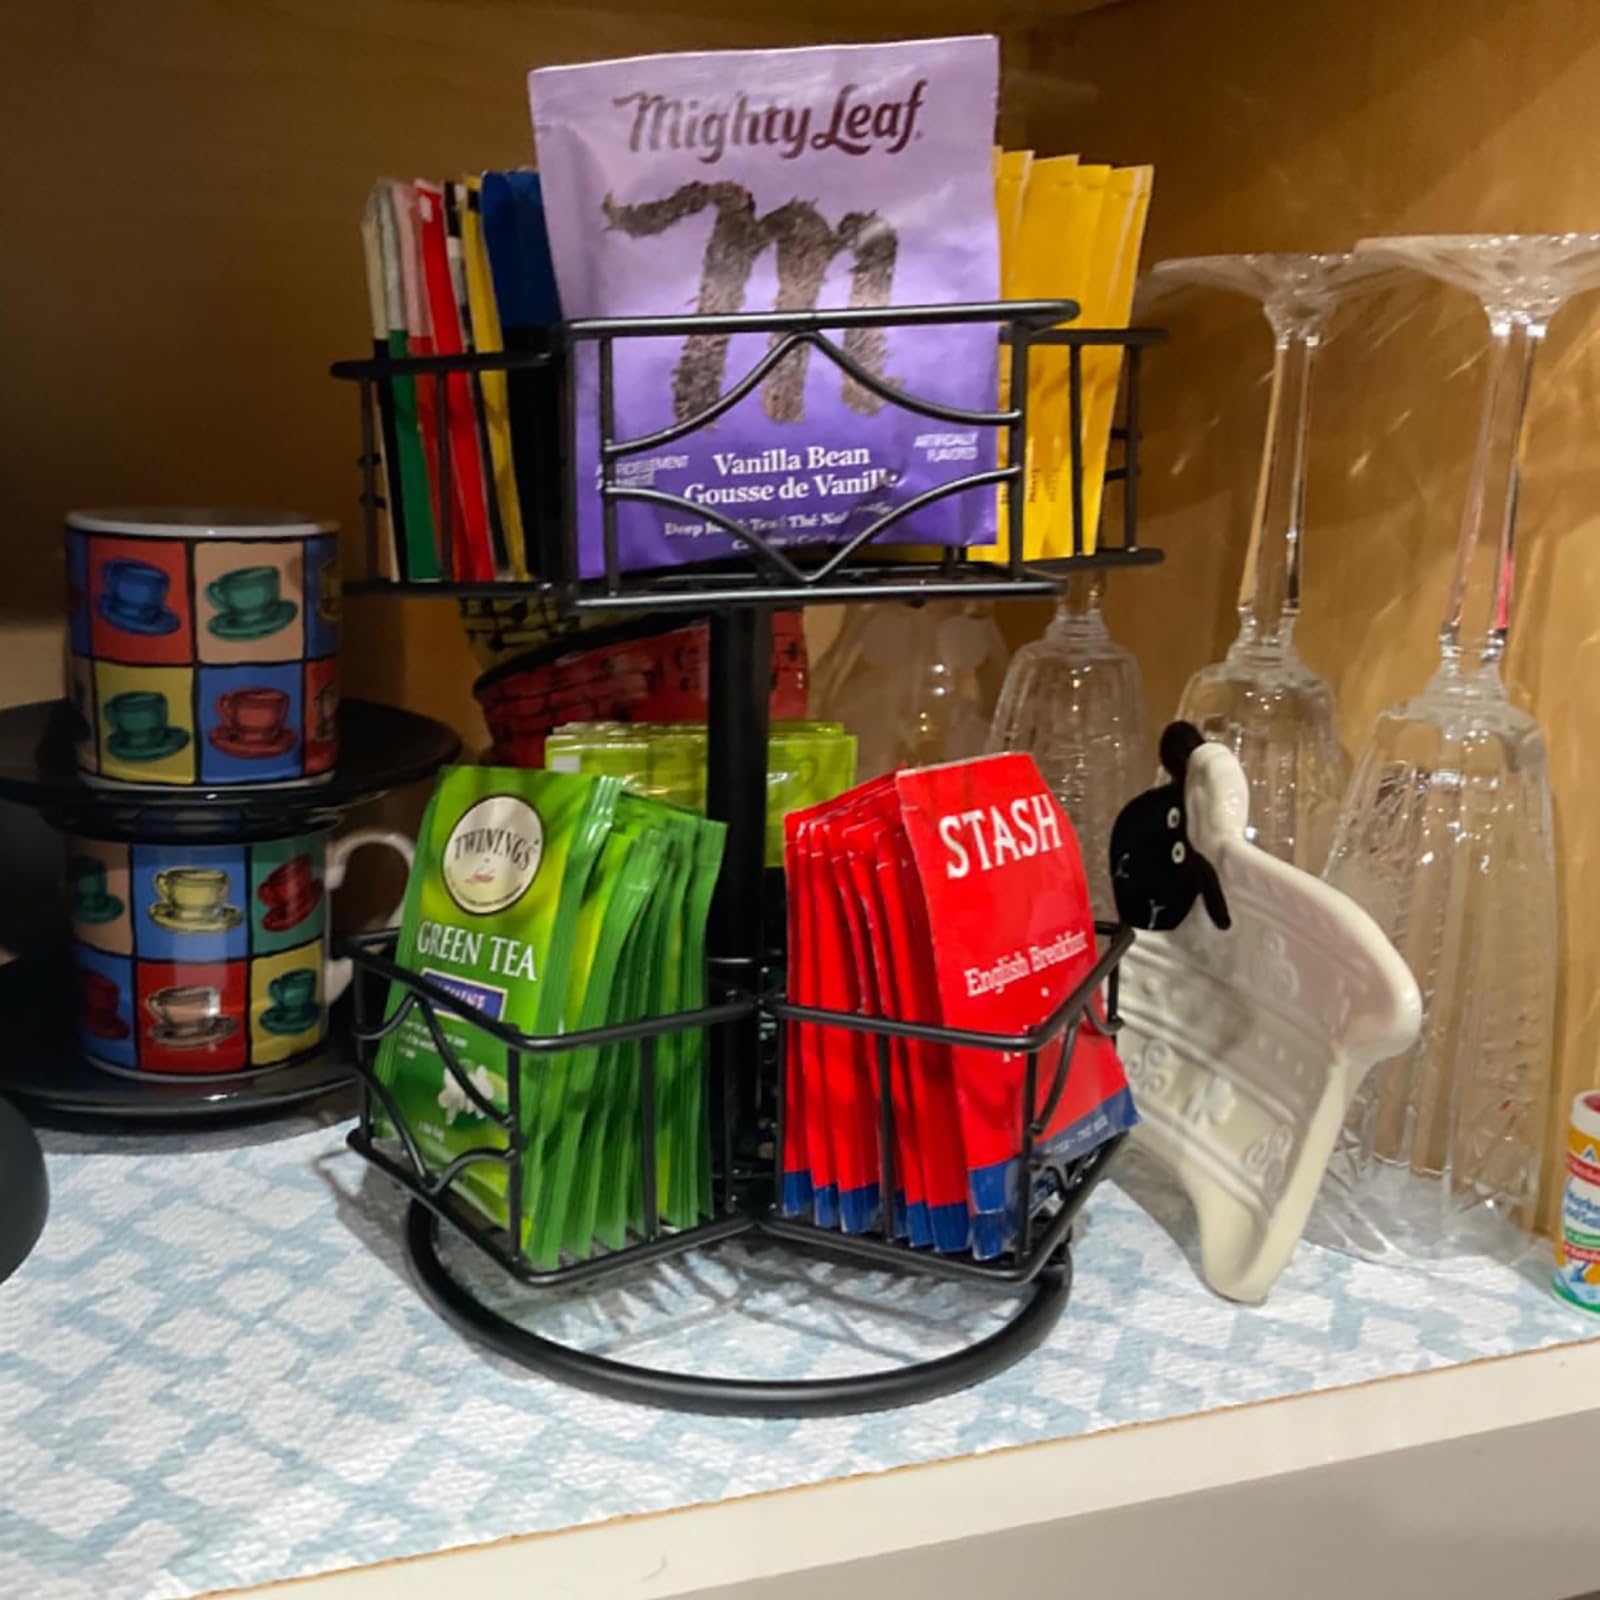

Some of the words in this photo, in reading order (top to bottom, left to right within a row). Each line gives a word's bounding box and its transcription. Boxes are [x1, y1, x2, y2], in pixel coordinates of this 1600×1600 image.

[612, 90, 812, 164] Mighty
[811, 79, 928, 156] Leaf
[684, 483, 774, 505] Gousse
[778, 477, 809, 500] de
[712, 448, 801, 476] Vanilla
[806, 446, 870, 470] Bean
[454, 827, 535, 871] TWININGS
[938, 793, 1063, 880] STASH
[417, 920, 485, 966] GREEN
[489, 936, 538, 982] TEA
[964, 951, 1031, 998] English
[1028, 930, 1089, 973] Breakfast
